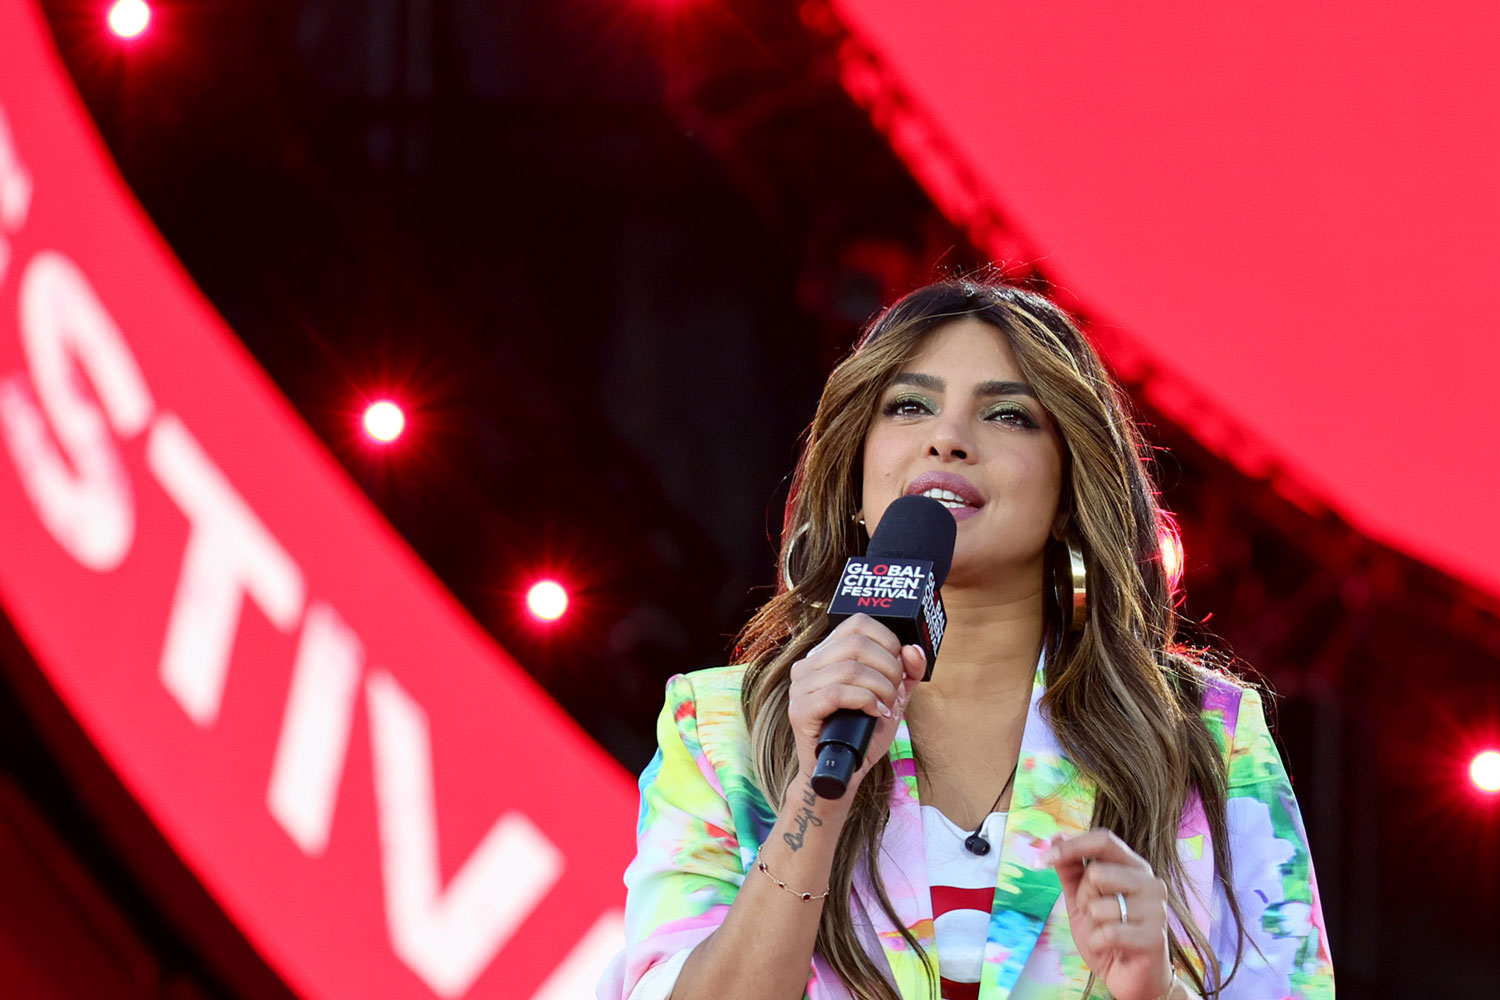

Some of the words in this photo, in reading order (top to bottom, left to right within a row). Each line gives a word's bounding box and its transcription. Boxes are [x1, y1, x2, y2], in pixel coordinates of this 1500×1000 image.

[847, 562, 925, 578] GLOBAL
[844, 574, 920, 589] CITIZEN
[841, 586, 918, 600] FESTIVAL
[857, 597, 893, 608] NYC
